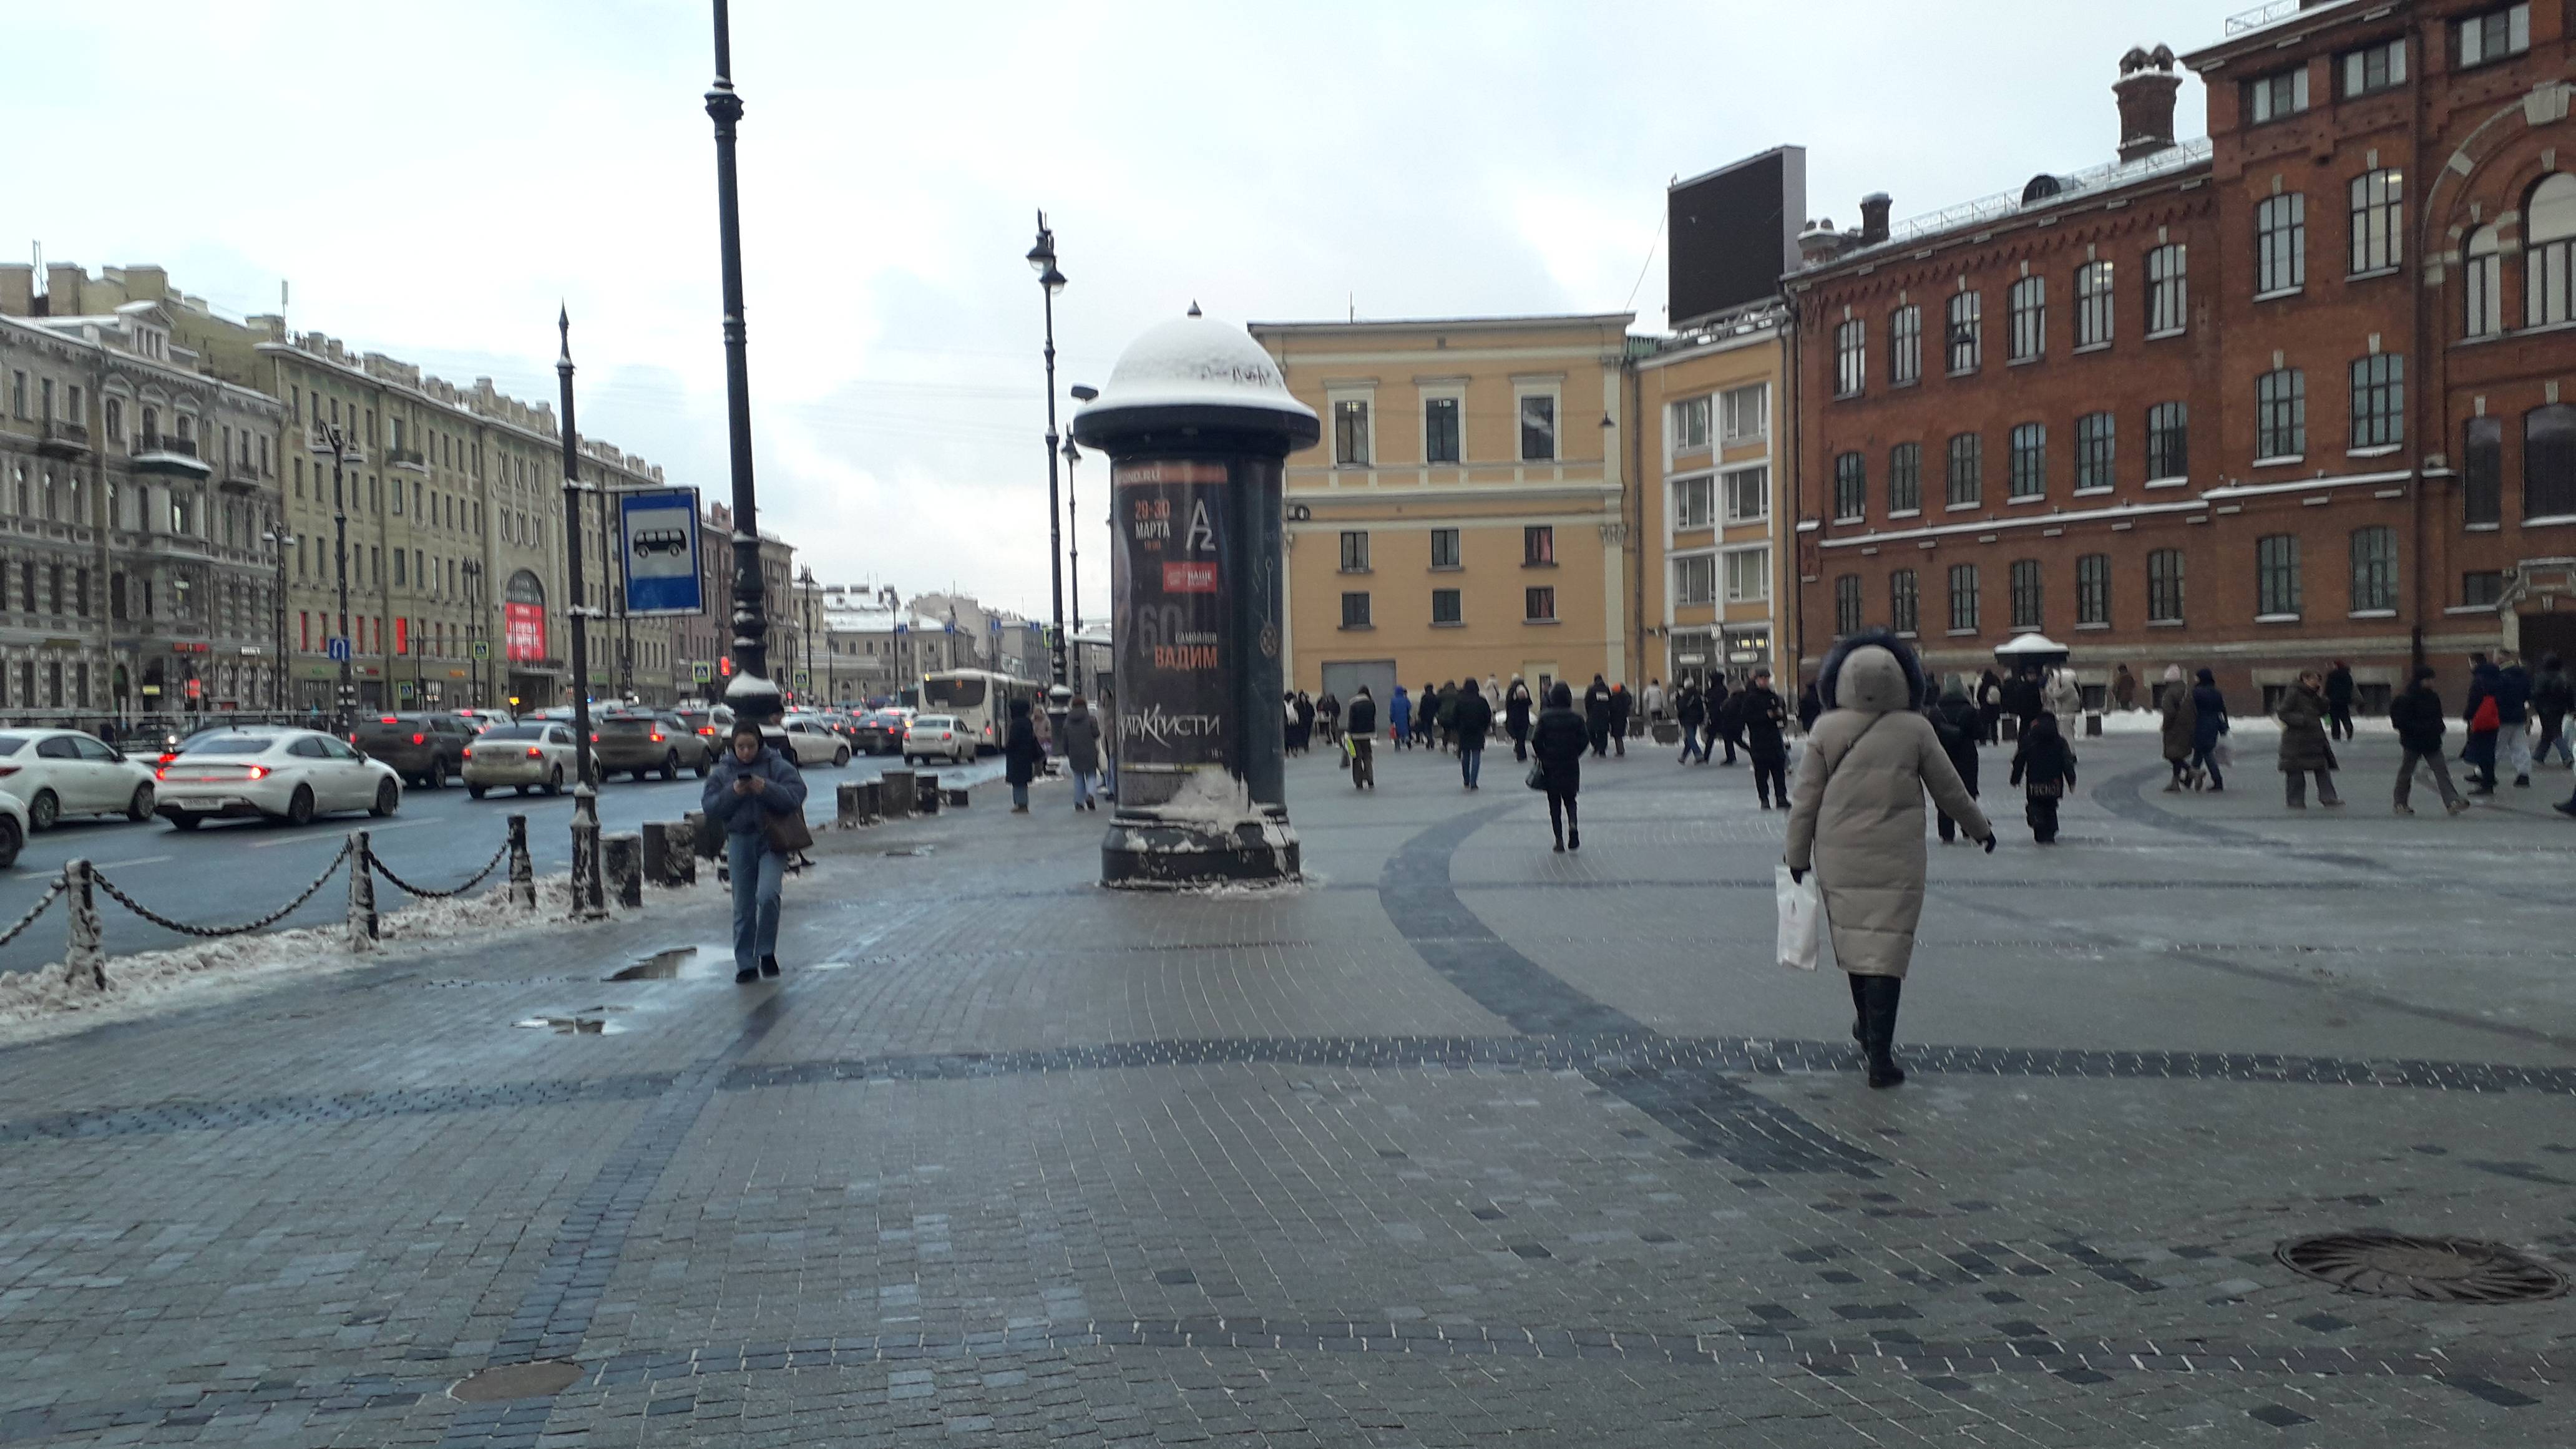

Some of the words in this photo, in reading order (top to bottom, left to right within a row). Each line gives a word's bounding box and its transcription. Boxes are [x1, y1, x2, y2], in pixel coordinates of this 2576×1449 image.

[1135, 520, 1171, 540] МАРТА
[1138, 603, 1183, 656] 60
[1155, 645, 1217, 671] ВАДИМ
